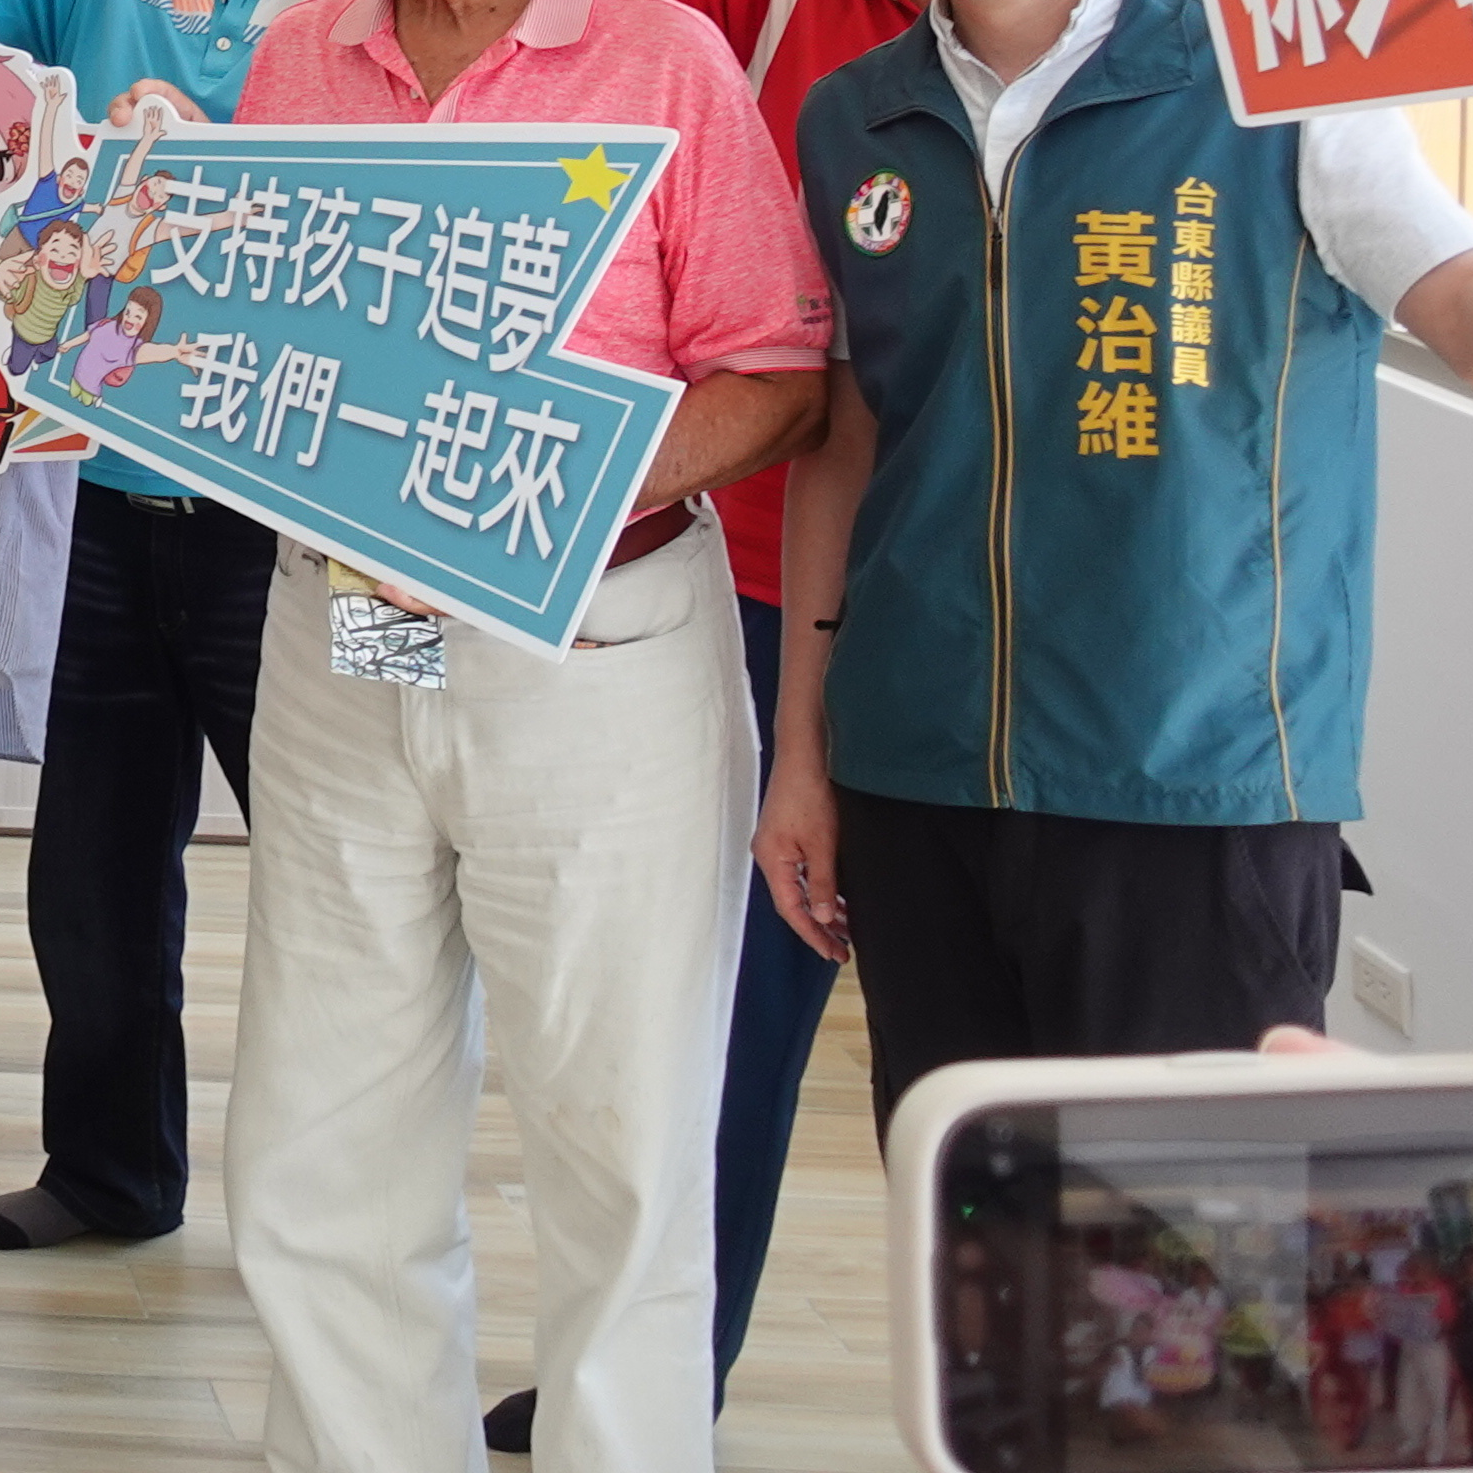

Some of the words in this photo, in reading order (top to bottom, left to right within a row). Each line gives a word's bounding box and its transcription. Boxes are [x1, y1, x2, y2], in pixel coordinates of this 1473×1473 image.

[152, 166, 570, 372] 支持孩子追夢
[1073, 209, 1161, 460] 黃治維
[1171, 177, 1217, 389] 台東縣議員
[179, 331, 580, 559] 我們一起來
